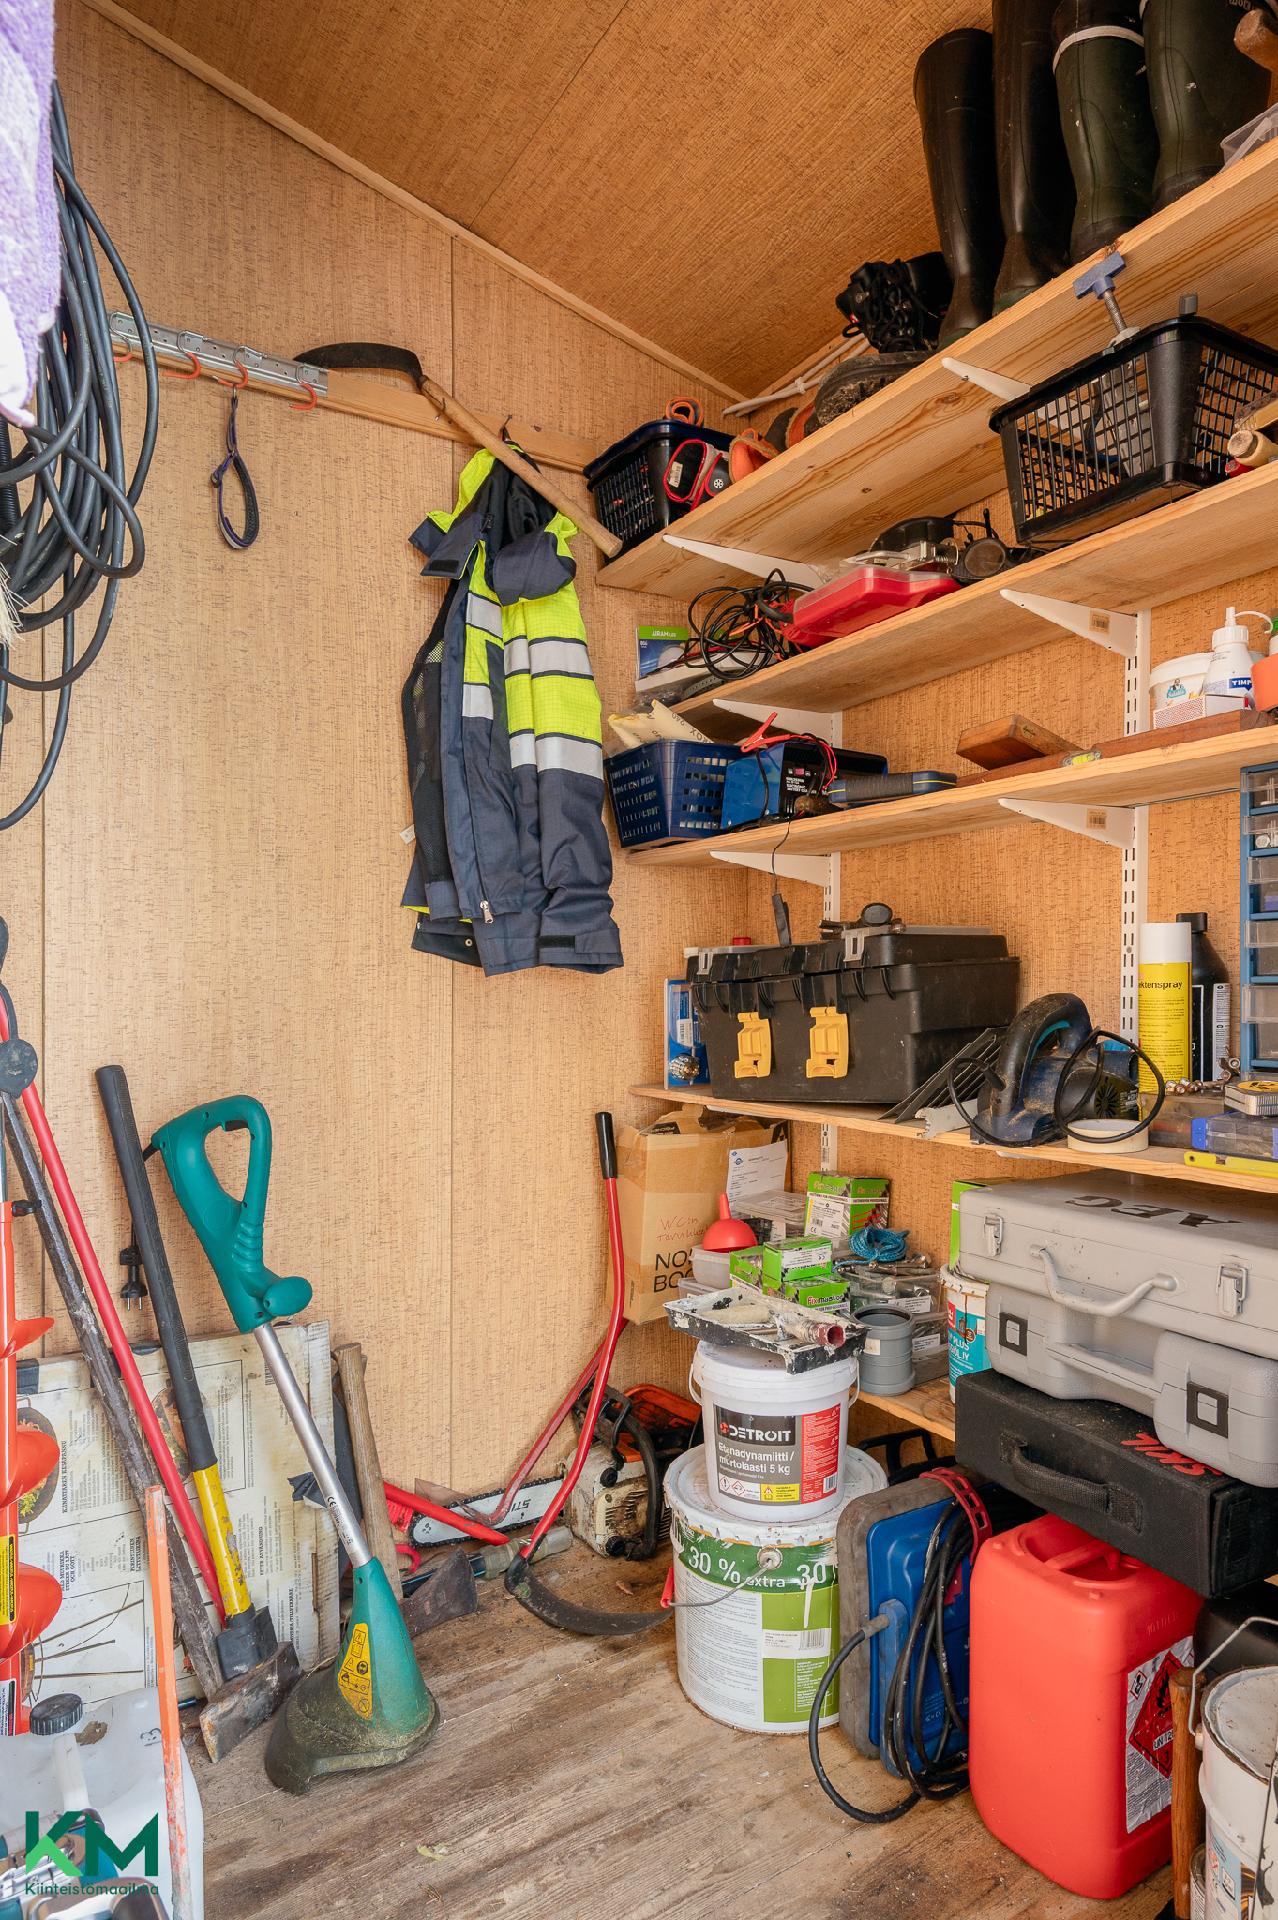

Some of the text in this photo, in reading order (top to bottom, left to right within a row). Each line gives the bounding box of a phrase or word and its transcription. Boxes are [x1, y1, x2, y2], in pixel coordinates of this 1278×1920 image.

[1065, 1195, 1244, 1227] AEG
[729, 1425, 791, 1442] DETROIT
[770, 1464, 775, 1473] 5
[778, 1464, 791, 1476] kg
[511, 1498, 531, 1512] STI
[688, 1546, 711, 1575] 30
[745, 1574, 786, 1588] extra
